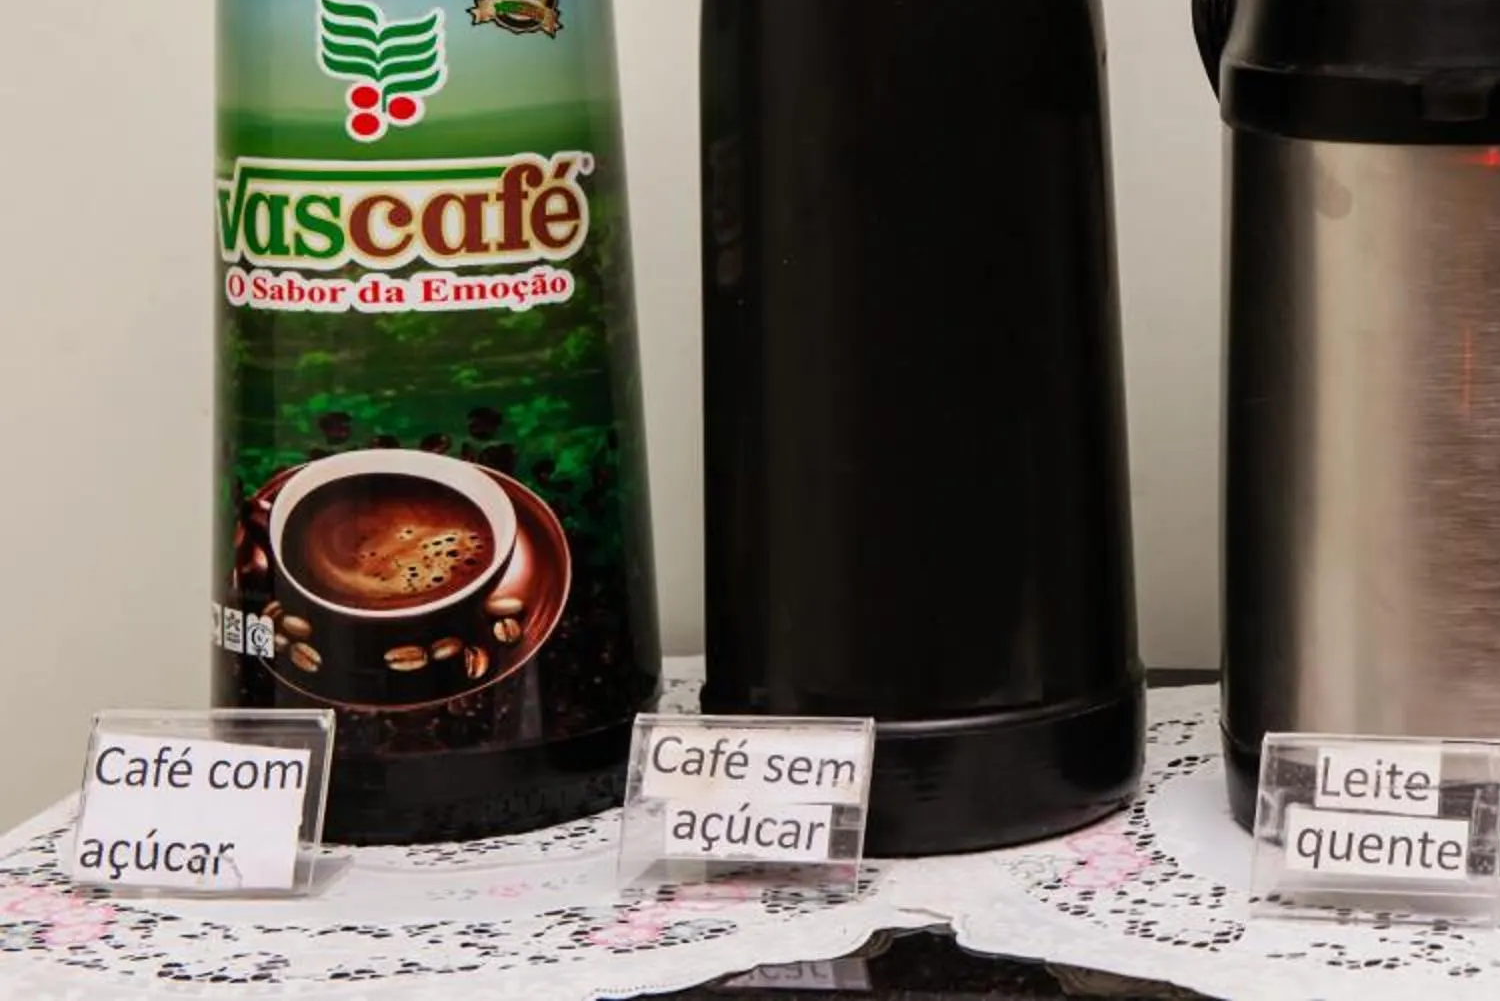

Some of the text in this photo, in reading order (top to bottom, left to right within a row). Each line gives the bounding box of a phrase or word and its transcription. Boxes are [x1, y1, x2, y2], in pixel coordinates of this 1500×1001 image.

[217, 161, 582, 260] Vascafé
[228, 274, 568, 305] O Sabor da Emoção
[95, 745, 304, 790] Café com
[651, 735, 856, 788] Café sem
[1319, 756, 1432, 802] Leite
[671, 802, 826, 852] açúcar
[1296, 827, 1463, 871] quente
[79, 828, 236, 880] açúcar
